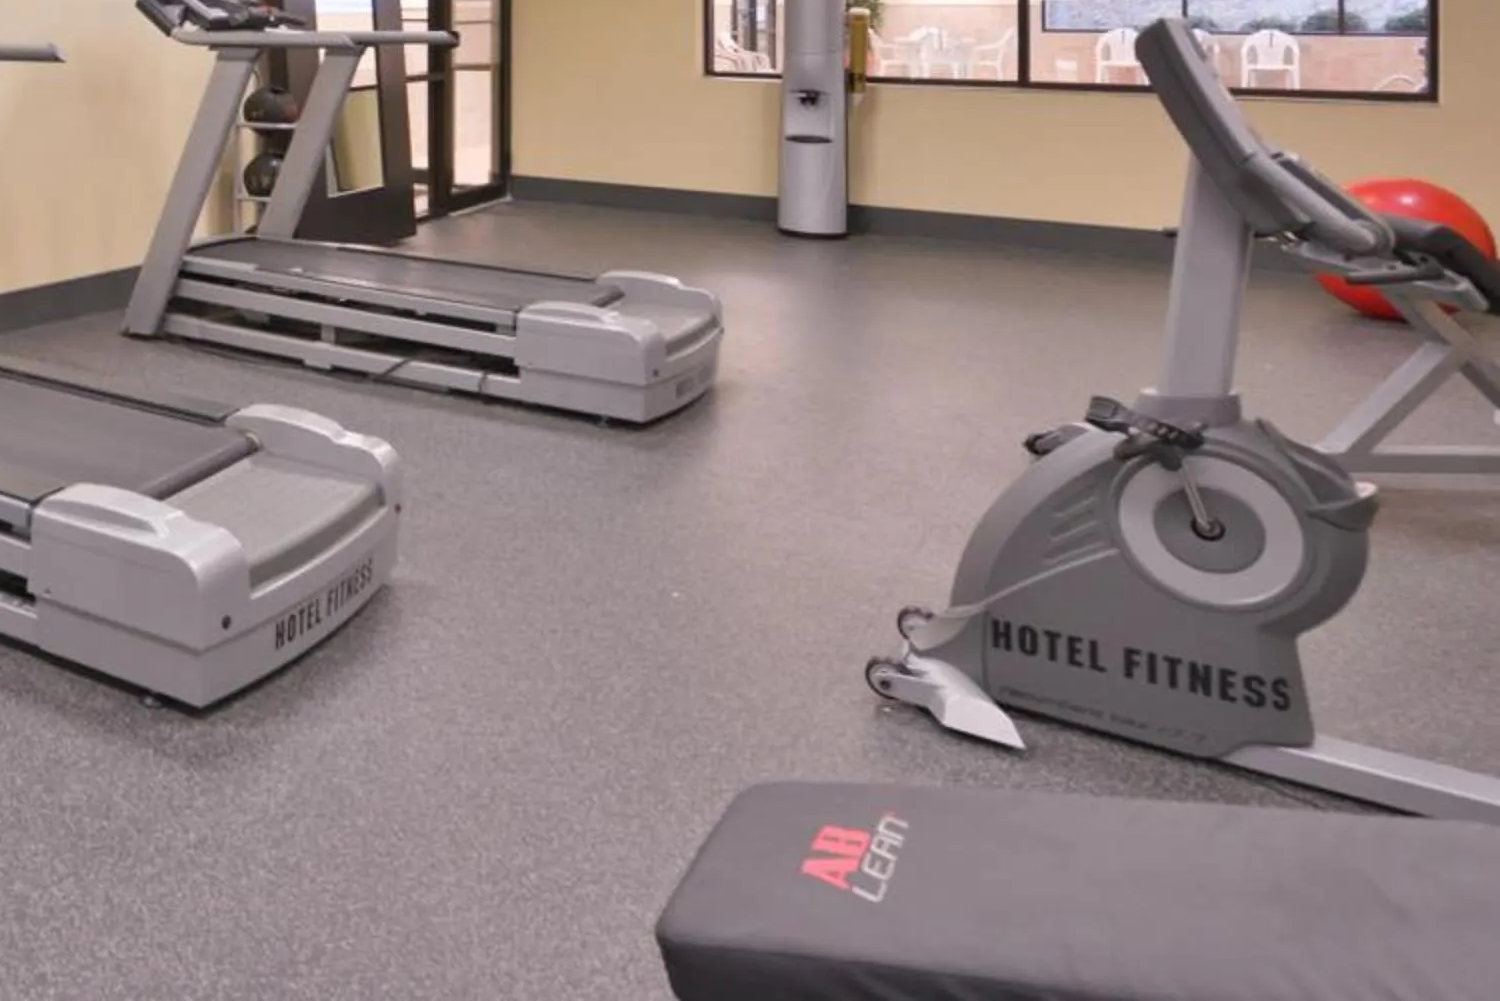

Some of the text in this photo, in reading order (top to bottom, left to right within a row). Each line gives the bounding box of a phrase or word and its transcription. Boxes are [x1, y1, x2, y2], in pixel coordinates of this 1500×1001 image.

[275, 558, 373, 649] HOTEL FITNESS
[991, 619, 1291, 711] HOTEL FITNESS
[802, 824, 871, 890] AB
